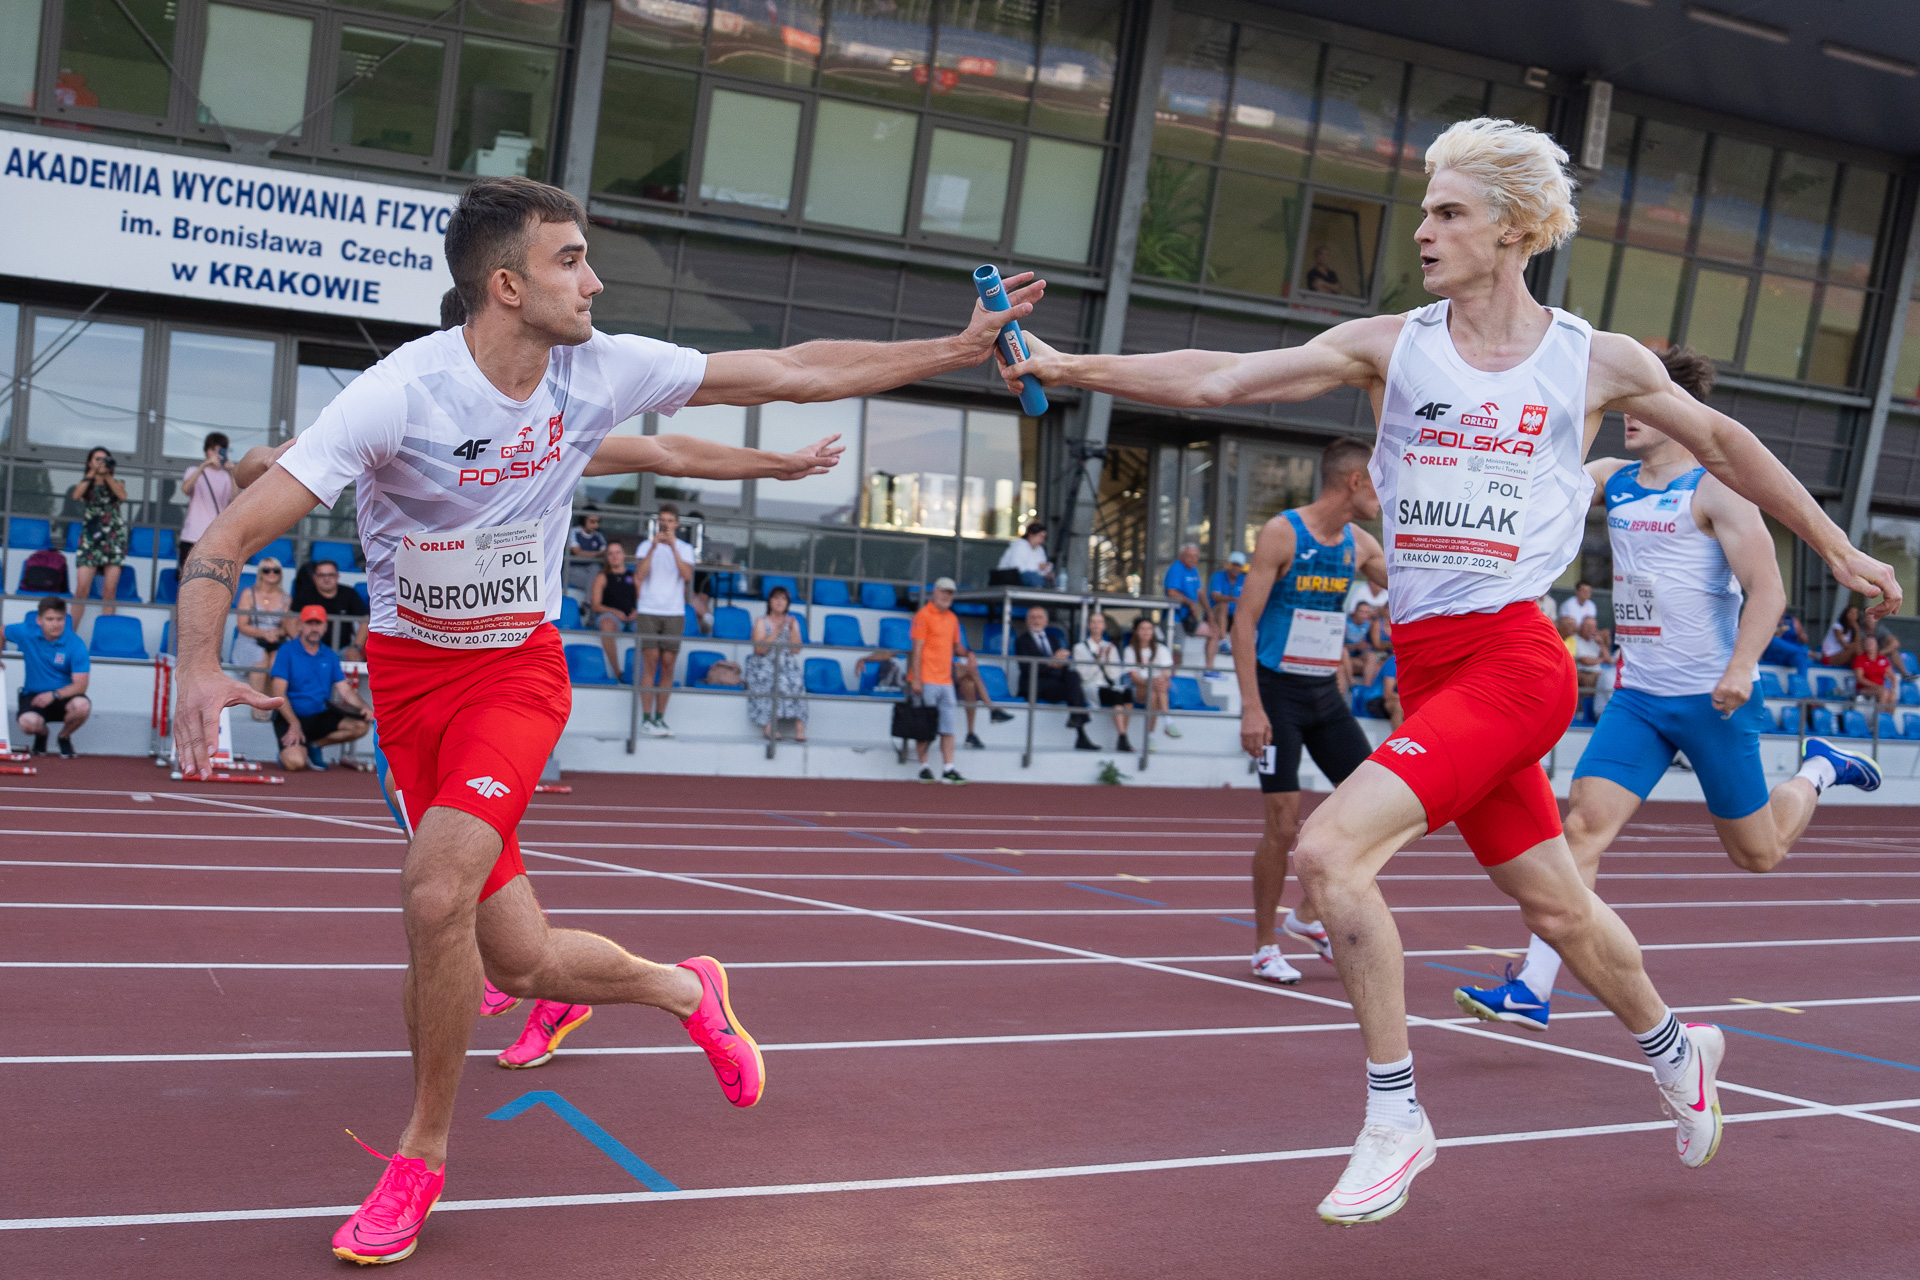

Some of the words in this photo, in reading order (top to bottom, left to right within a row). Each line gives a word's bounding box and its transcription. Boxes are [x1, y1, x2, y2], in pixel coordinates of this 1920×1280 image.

[4, 147, 162, 196] AKADEMIA
[172, 169, 366, 224] WYCHOWANIA
[376, 198, 451, 235] FIZYC
[120, 210, 161, 236] im.
[172, 216, 323, 258] Bronisława
[340, 239, 433, 271] Czecha
[171, 262, 198, 282] w
[209, 261, 381, 304] KRAKOWIE
[1415, 402, 1452, 421] 4F
[1462, 416, 1496, 428] ORLEN
[453, 439, 492, 460] 4F
[1419, 428, 1535, 458] POLSKA
[459, 446, 561, 487] POLSKA
[1420, 456, 1458, 467] ORLEN
[1486, 458, 1519, 467] Ministerstwo
[1505, 466, 1529, 475] Turystyki
[1488, 481, 1523, 500] POL
[1398, 499, 1519, 535] SAMULAK
[1630, 519, 1676, 533] REPUBLIC
[493, 529, 527, 538] Ministerstwo
[493, 537, 511, 545] Sportu
[515, 533, 538, 542] Turystyki
[420, 540, 465, 552] ORLEN
[502, 551, 537, 567] POL
[1402, 552, 1441, 563] KRAKÓW
[1442, 555, 1499, 570] 20.07.2024
[1296, 575, 1349, 593] UKRAINE
[398, 575, 538, 613] DĄBROWSKI
[1637, 589, 1654, 598] CZE
[411, 626, 461, 644] KRAKÓW
[465, 632, 528, 645] 20.07.2024
[1386, 737, 1427, 755] 4F
[466, 776, 511, 799] 4F
